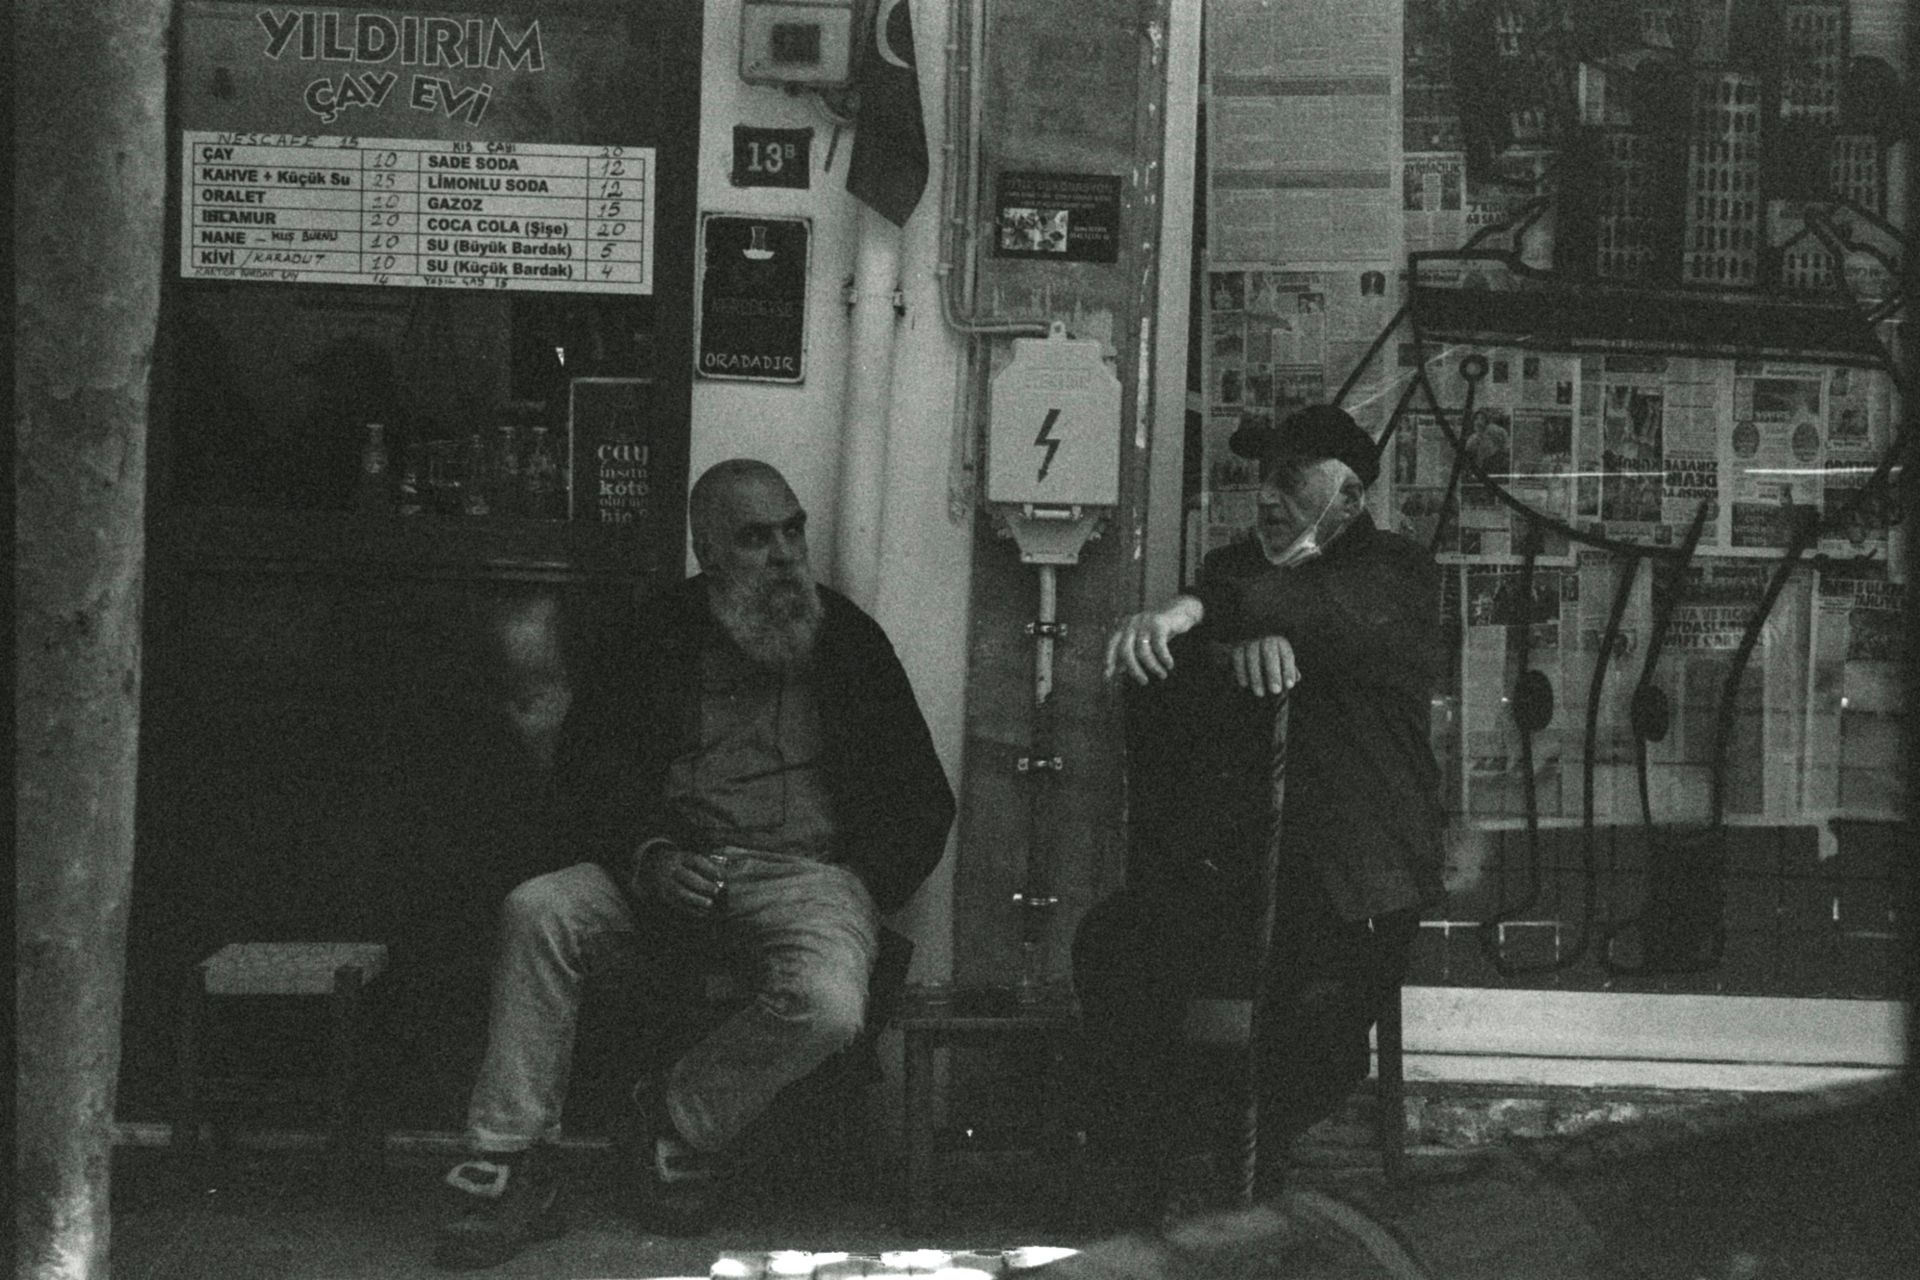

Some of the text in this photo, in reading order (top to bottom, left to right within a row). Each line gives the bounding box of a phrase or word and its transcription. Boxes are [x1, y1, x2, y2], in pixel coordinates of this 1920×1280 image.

[256, 8, 545, 72] YILDIRIM
[304, 71, 398, 123] ÇAY
[202, 147, 398, 168] ÇAY 10
[428, 155, 625, 177] SADE SODA 12
[202, 167, 259, 182] KAHVE
[277, 170, 326, 187] Küçük
[331, 172, 351, 186] Su
[428, 172, 623, 199] LİMONLU SODA 12
[202, 188, 266, 203] ORALET
[427, 197, 483, 212] GAZOZ
[427, 217, 626, 238] COCA COLA (Şişe) 20
[201, 230, 246, 244] NANE
[371, 234, 400, 249] 10
[427, 238, 617, 259] SU (Büyük Bardak) 5
[372, 255, 396, 270] 10
[426, 259, 614, 280] SU (Küçük Bardak) 4
